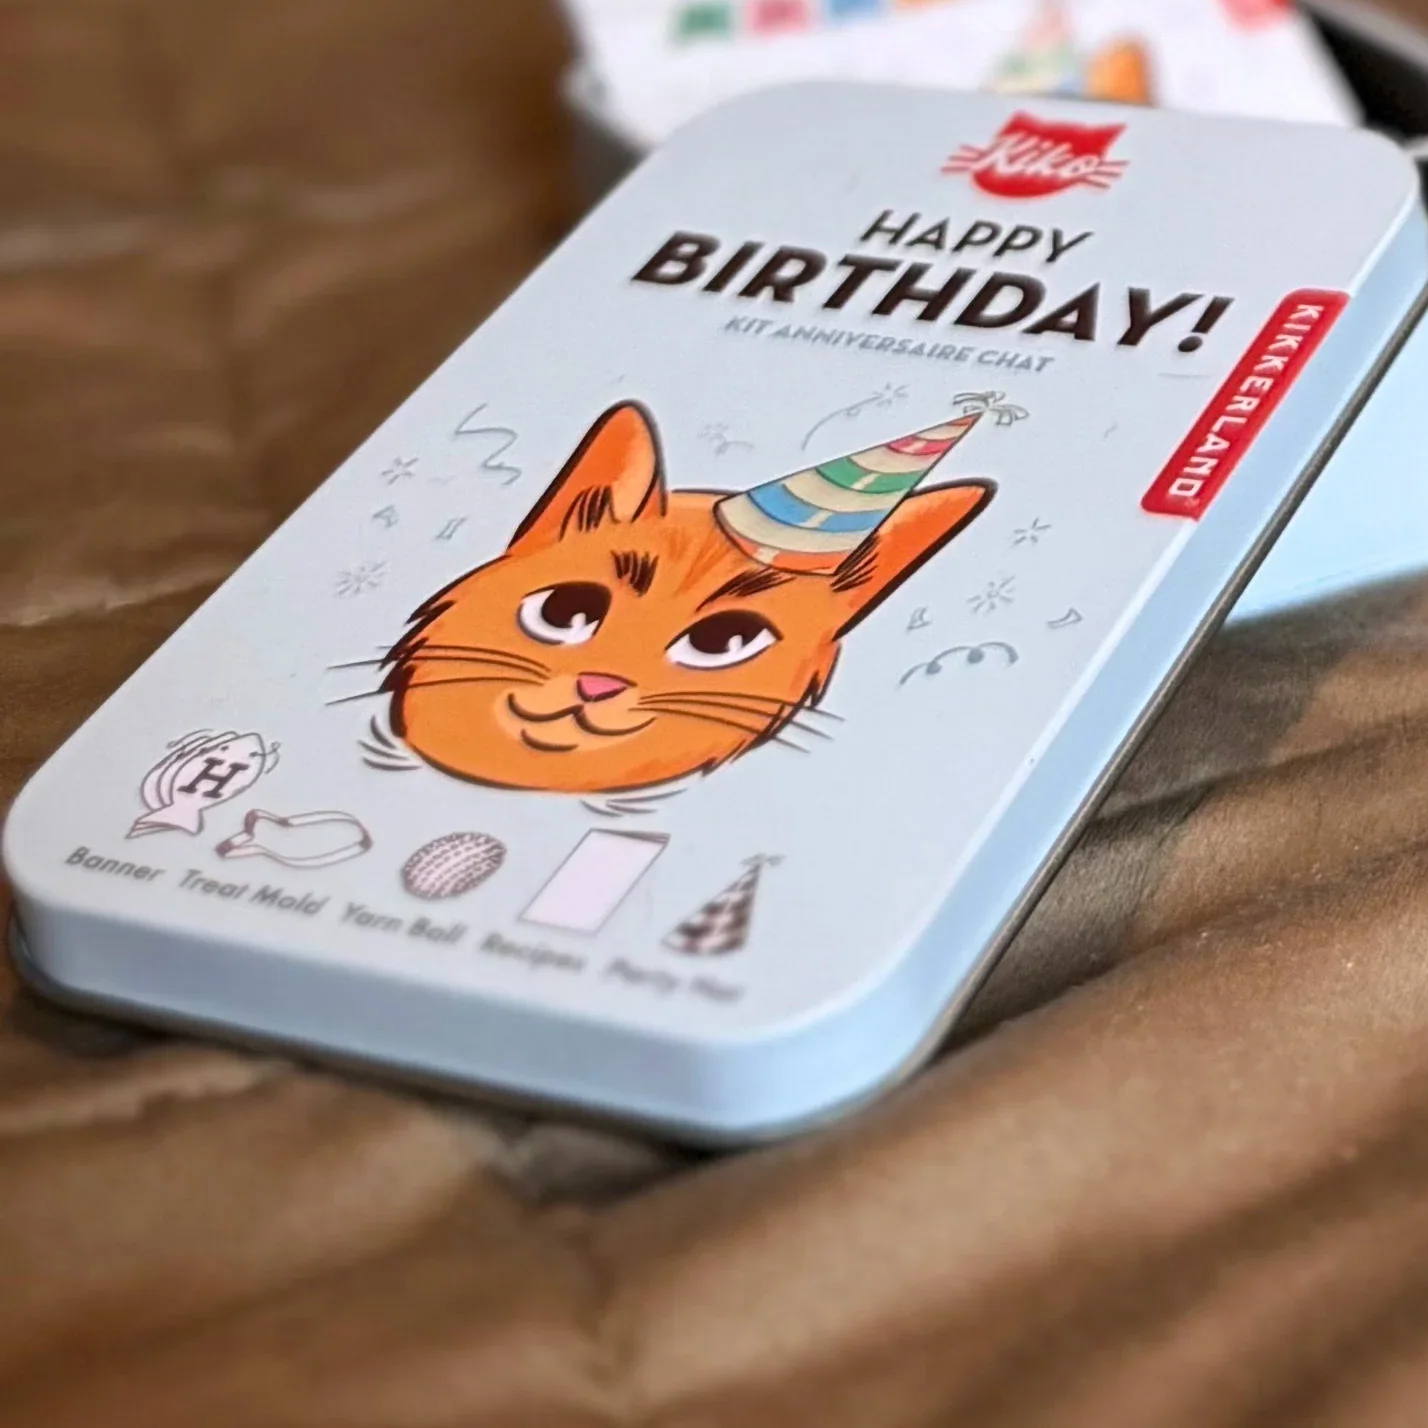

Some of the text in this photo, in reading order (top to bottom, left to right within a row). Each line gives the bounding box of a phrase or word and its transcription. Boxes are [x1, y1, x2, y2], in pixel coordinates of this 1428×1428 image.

[860, 209, 1094, 264] HAPPY
[630, 230, 1236, 353] BIRTHDAY!
[724, 315, 1055, 373] KIT ANNIVERSAIRE CHAT
[1168, 304, 1325, 498] KIKKERLAND
[177, 756, 249, 799] H
[65, 846, 166, 882] Banner
[178, 867, 330, 916] Treat Mold
[340, 901, 468, 945] Yarn Ball
